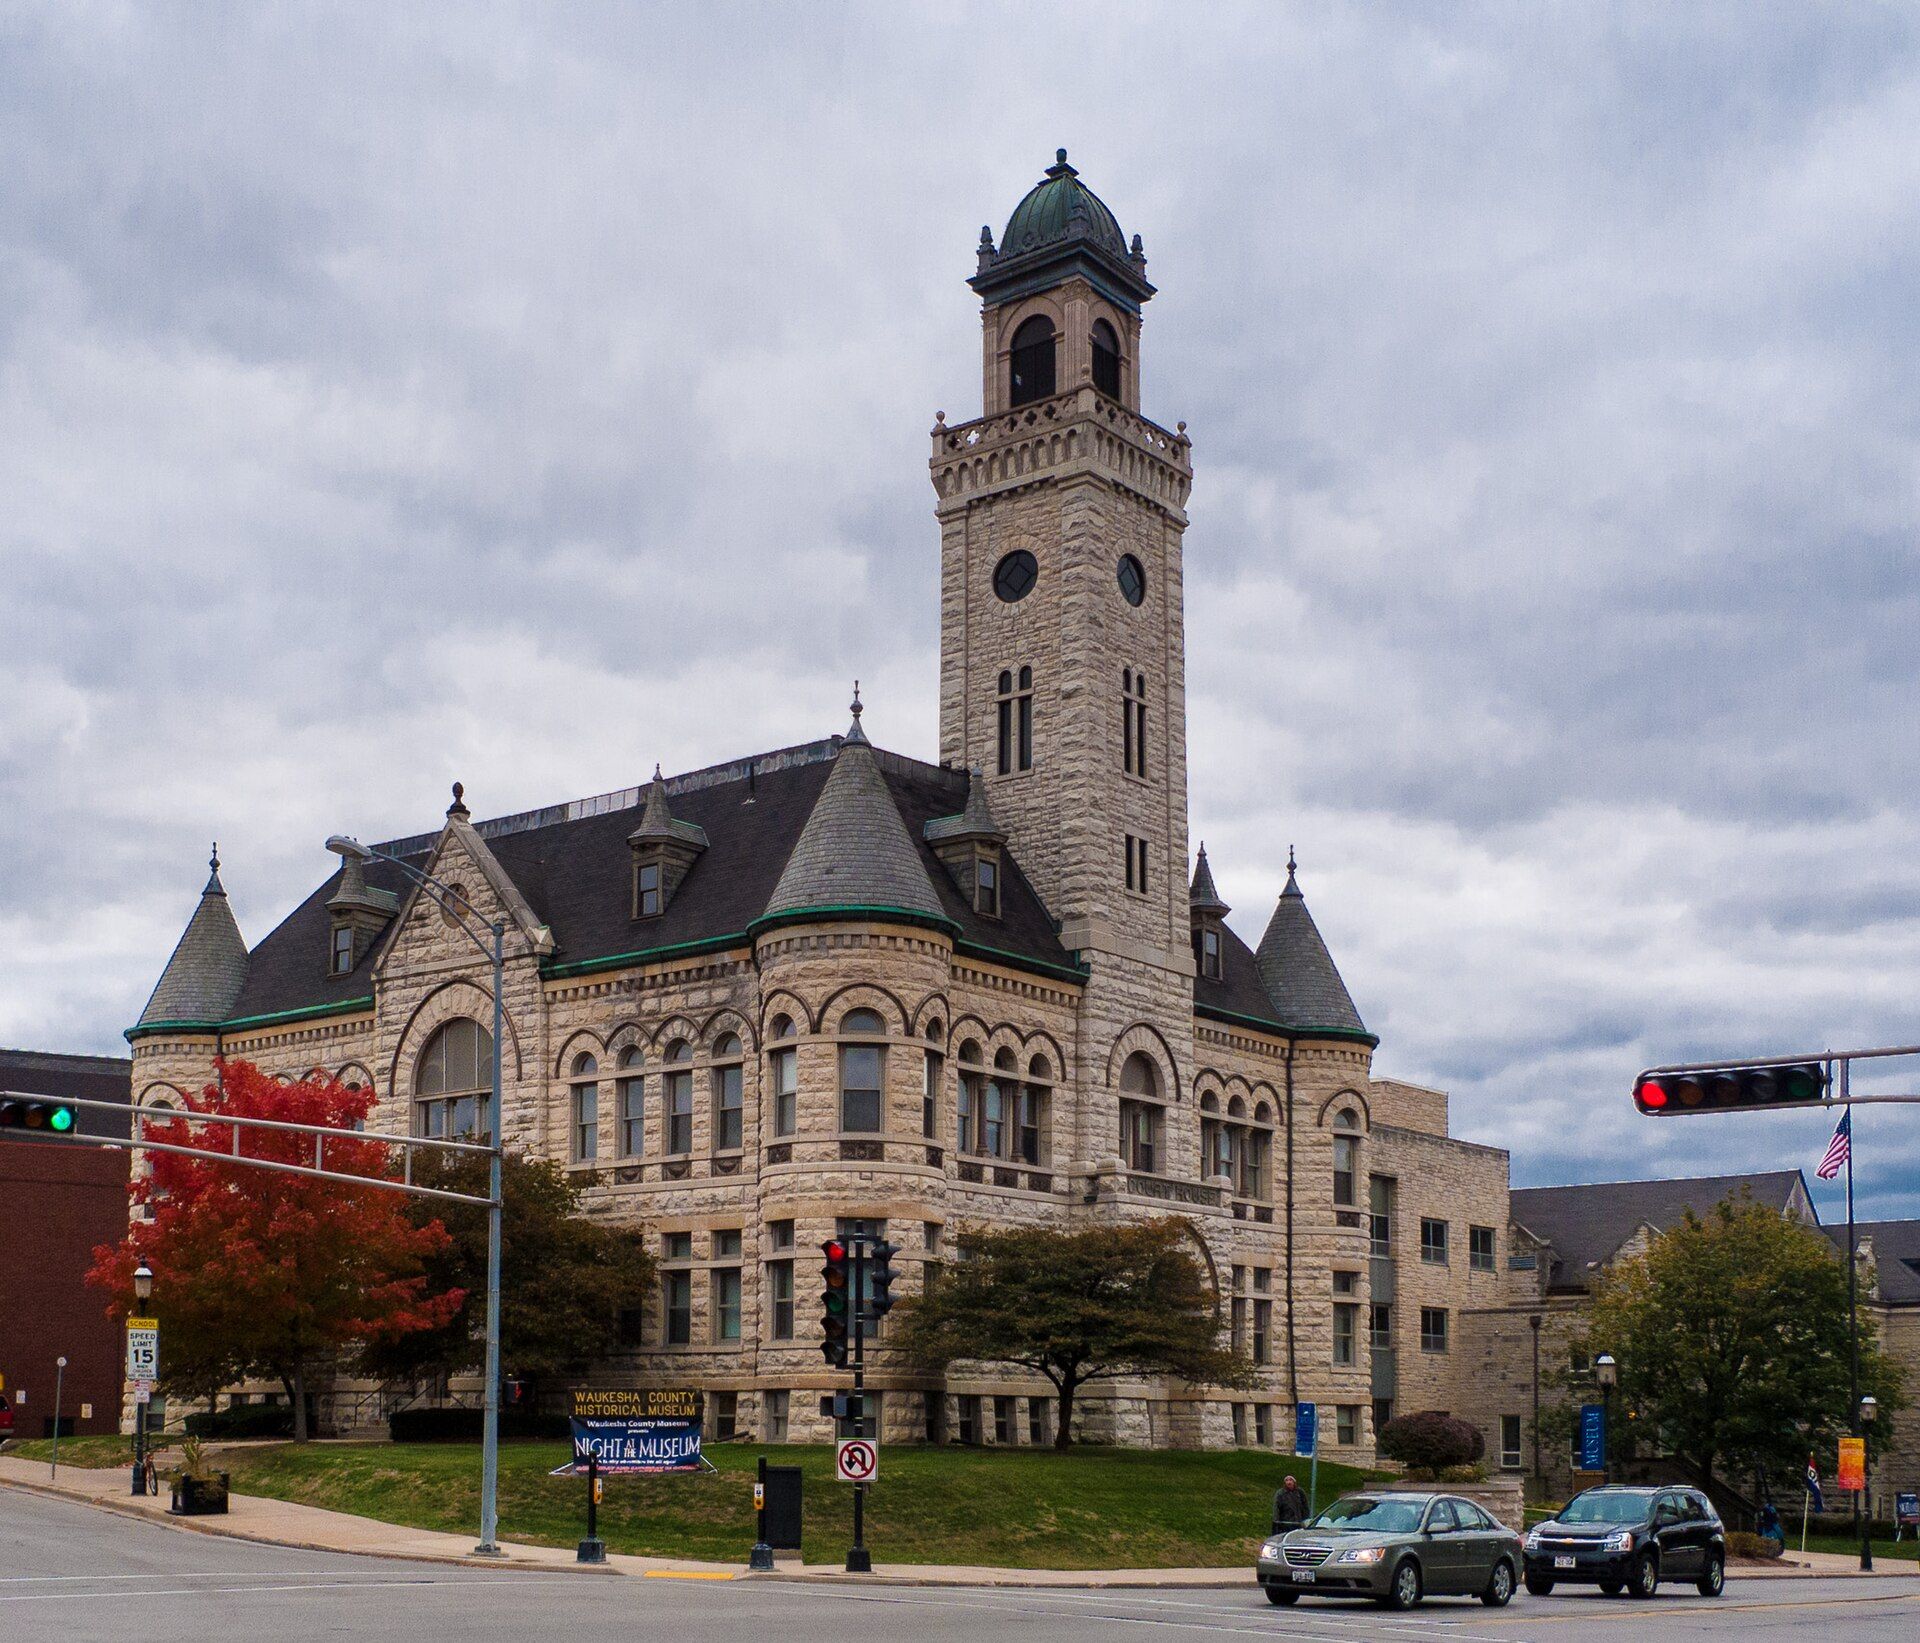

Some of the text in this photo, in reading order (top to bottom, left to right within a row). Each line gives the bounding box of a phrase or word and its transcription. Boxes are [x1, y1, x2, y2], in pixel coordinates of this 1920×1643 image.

[1128, 1178, 1217, 1207] COURT HOUSE
[133, 1349, 154, 1363] 15
[575, 1392, 695, 1402] WAUKESHA COUNTY
[575, 1405, 695, 1416] HISTORICAL MUSEUM
[574, 1436, 700, 1458] NIGHT AT THE MUSEUM
[1586, 1413, 1599, 1464] MUSEUM
